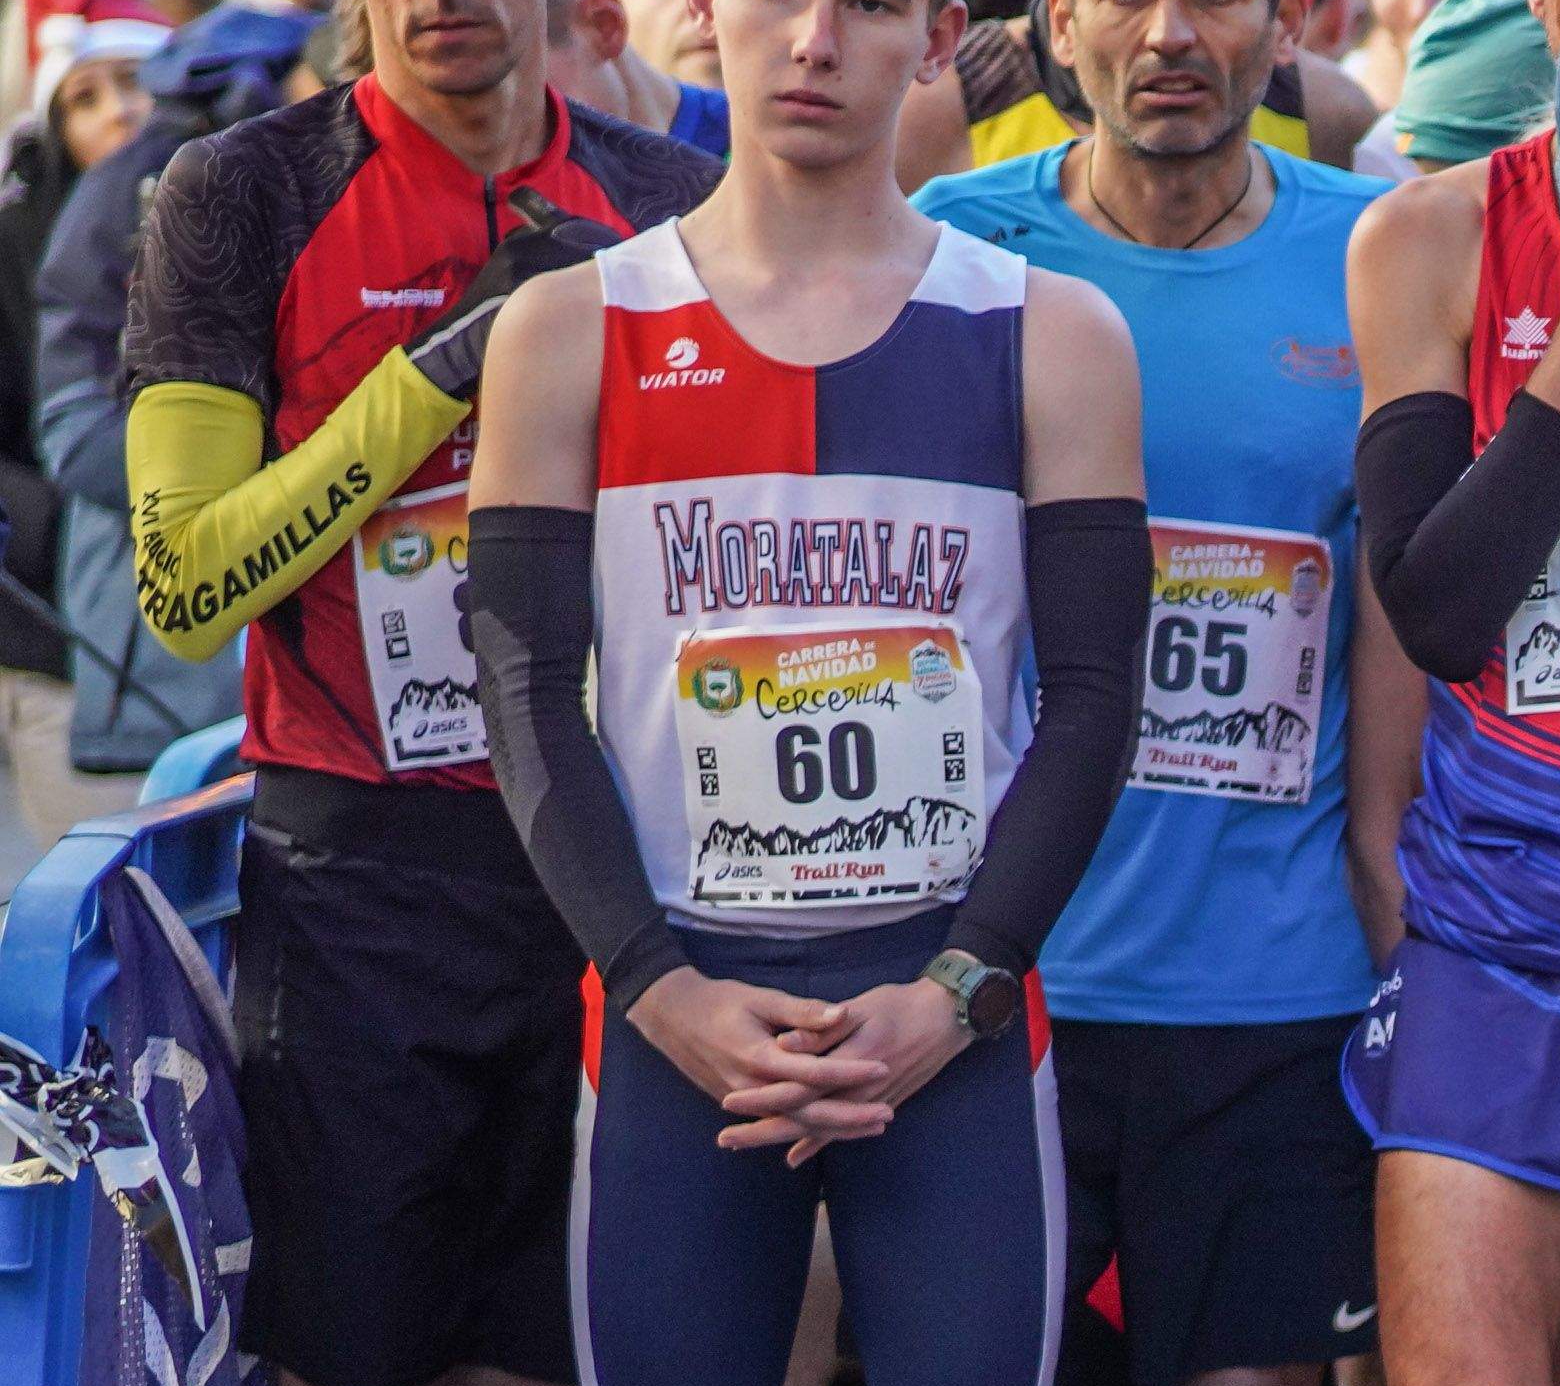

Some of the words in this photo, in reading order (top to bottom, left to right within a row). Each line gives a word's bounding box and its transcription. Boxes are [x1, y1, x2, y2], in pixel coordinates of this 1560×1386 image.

[639, 367, 726, 391] VIATOR
[1170, 543, 1251, 562] CARRERA
[1168, 558, 1265, 580] NAVIDAD
[777, 637, 862, 669] CARRERA
[1150, 615, 1249, 698] 65
[778, 651, 877, 688] NAVIDAD
[429, 715, 468, 735] asics
[774, 719, 878, 804] 60
[1149, 747, 1196, 769] Trail
[1199, 751, 1238, 773] Run
[731, 865, 763, 880] asics
[791, 861, 840, 882] Trail
[842, 861, 886, 881] Run
